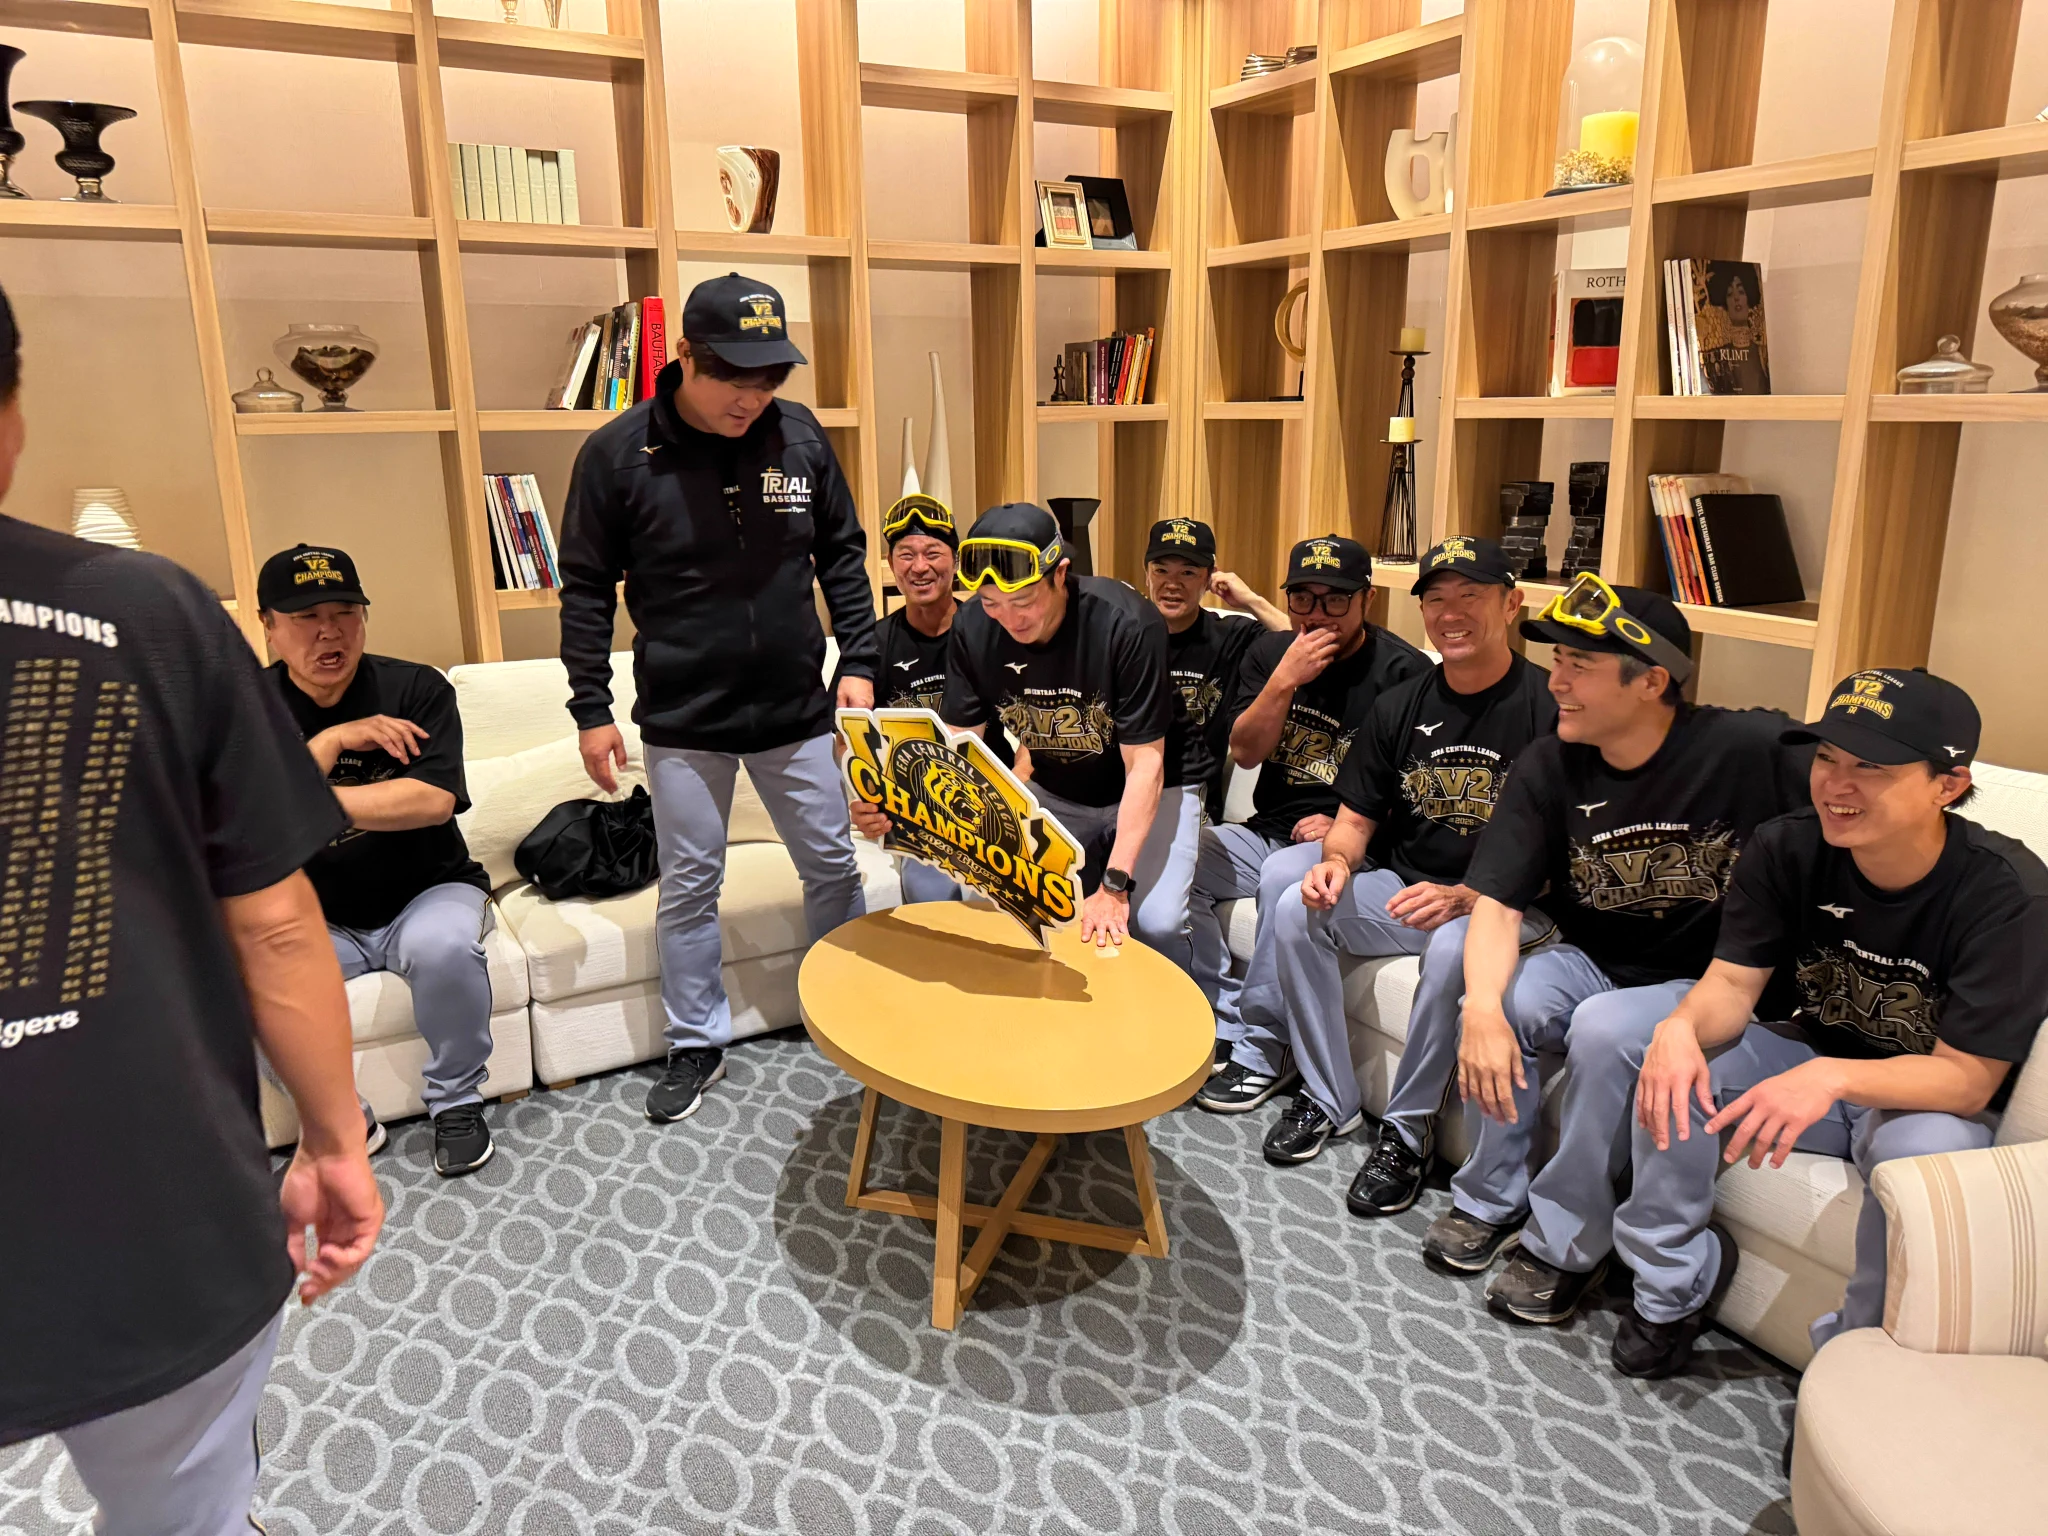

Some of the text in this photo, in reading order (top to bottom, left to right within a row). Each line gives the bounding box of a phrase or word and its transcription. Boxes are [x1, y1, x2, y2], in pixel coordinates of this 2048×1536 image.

[1586, 275, 1626, 288] ROTH
[1719, 349, 1750, 361] KLIMT
[760, 472, 812, 494] TRIAL
[762, 495, 812, 503] BASEBALL
[1694, 497, 1704, 517] HOTEL
[1172, 524, 1190, 534] V2
[1699, 516, 1713, 553] RESTAURANT
[1161, 532, 1197, 546] CHAMPIONS
[1443, 540, 1465, 551] V2
[1311, 546, 1332, 557] V2
[1431, 549, 1477, 567] CHAMPIONS
[1707, 552, 1715, 566] BAR
[303, 559, 331, 571] V2
[1301, 556, 1341, 569] CHAMPIONS
[293, 570, 344, 585] CHAMPIONS
[1710, 565, 1719, 581] CLUB
[1058, 688, 1083, 699] LEAGUE
[1853, 679, 1885, 698] V2
[1029, 704, 1085, 738] V2
[1020, 730, 1104, 755] CHAMPIONS
[1445, 744, 1476, 753] CENTRAL
[1477, 746, 1502, 761] LEAGUE
[1433, 766, 1493, 801] V2
[896, 742, 1018, 843] JERA CENTRAL LEAGUE
[1454, 817, 1475, 826] 2026
[848, 756, 1076, 921] CHAMPIONS
[1591, 822, 1690, 844] JERA CENTRAL LEAGUE
[917, 829, 1004, 886] 2026 Tigers
[1602, 842, 1691, 886] V2
[1591, 876, 1718, 910] CHAMPIONS
[1848, 962, 1923, 1031] V2
